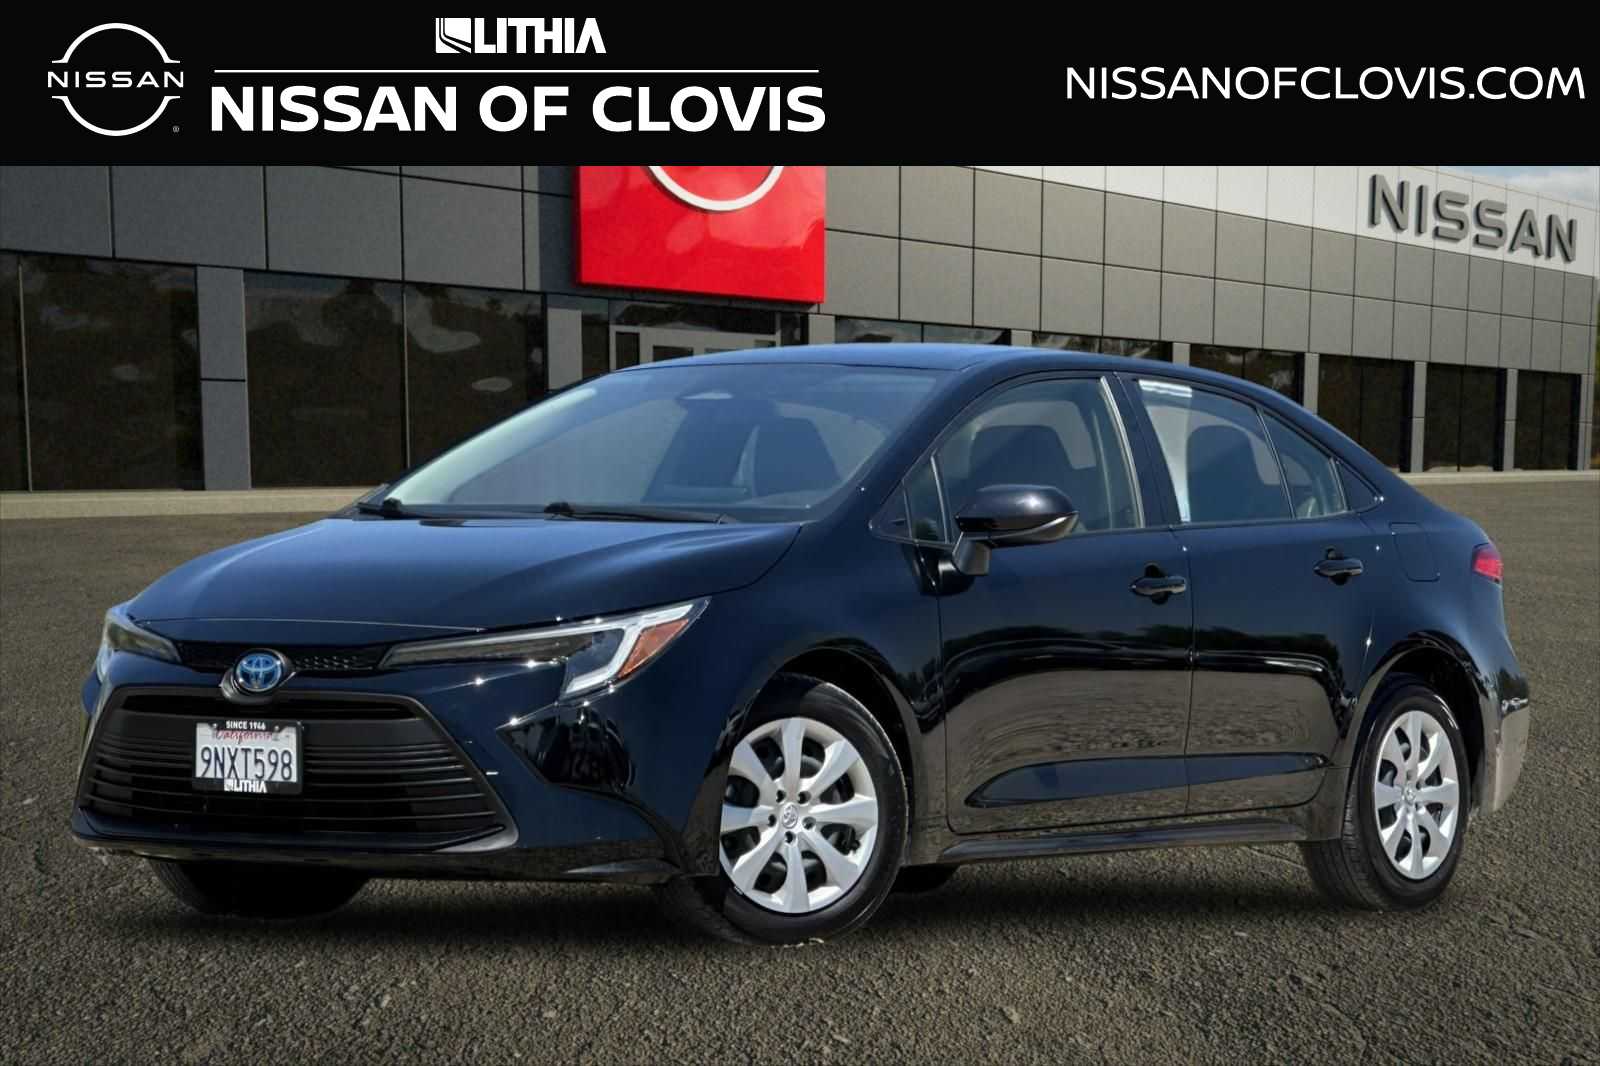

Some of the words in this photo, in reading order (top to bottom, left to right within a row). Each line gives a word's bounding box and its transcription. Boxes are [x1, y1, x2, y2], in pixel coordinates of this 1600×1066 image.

[1368, 174, 1577, 263] NISSAN
[225, 721, 248, 730] SINCE
[201, 746, 293, 781] 9NXT598
[233, 779, 268, 793] LITHIA
